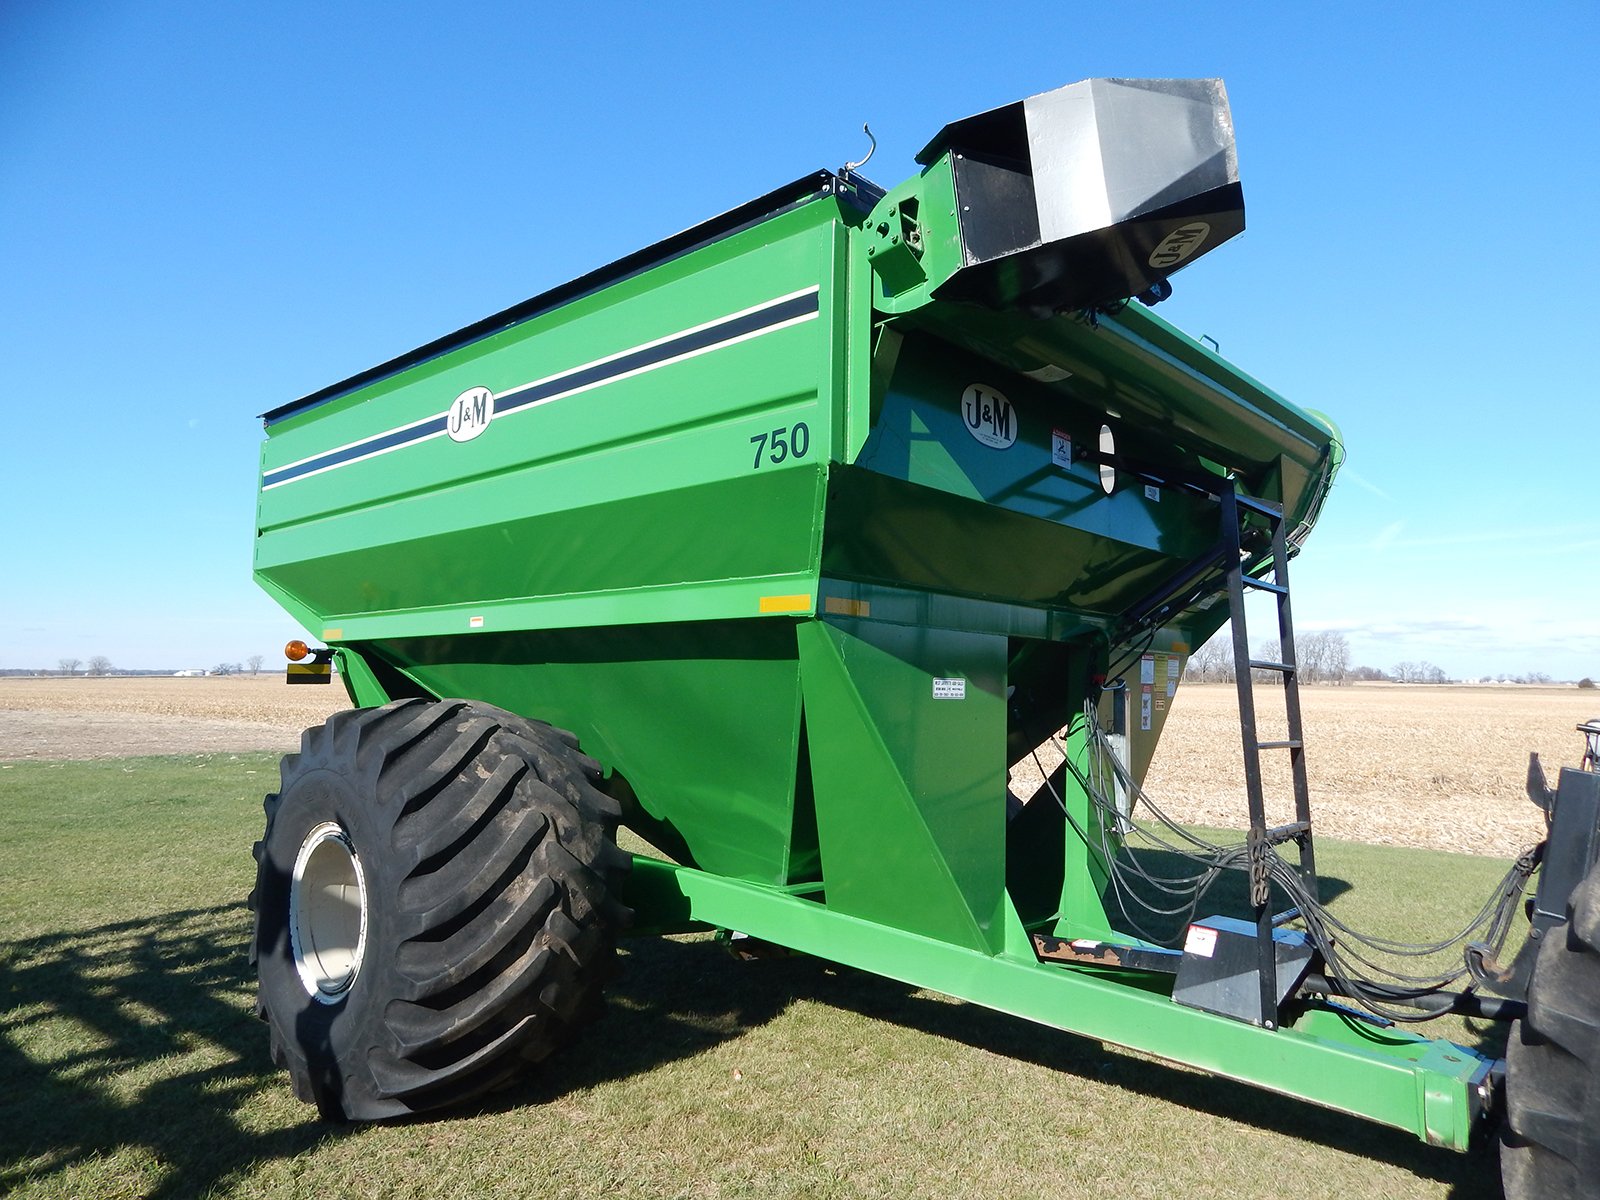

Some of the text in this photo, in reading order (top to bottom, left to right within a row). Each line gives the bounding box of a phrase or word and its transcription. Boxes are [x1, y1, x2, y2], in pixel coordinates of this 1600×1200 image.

[1154, 228, 1205, 265] J&M
[451, 392, 488, 434] J&M
[965, 389, 1012, 442] J&M
[750, 421, 810, 470] 750
